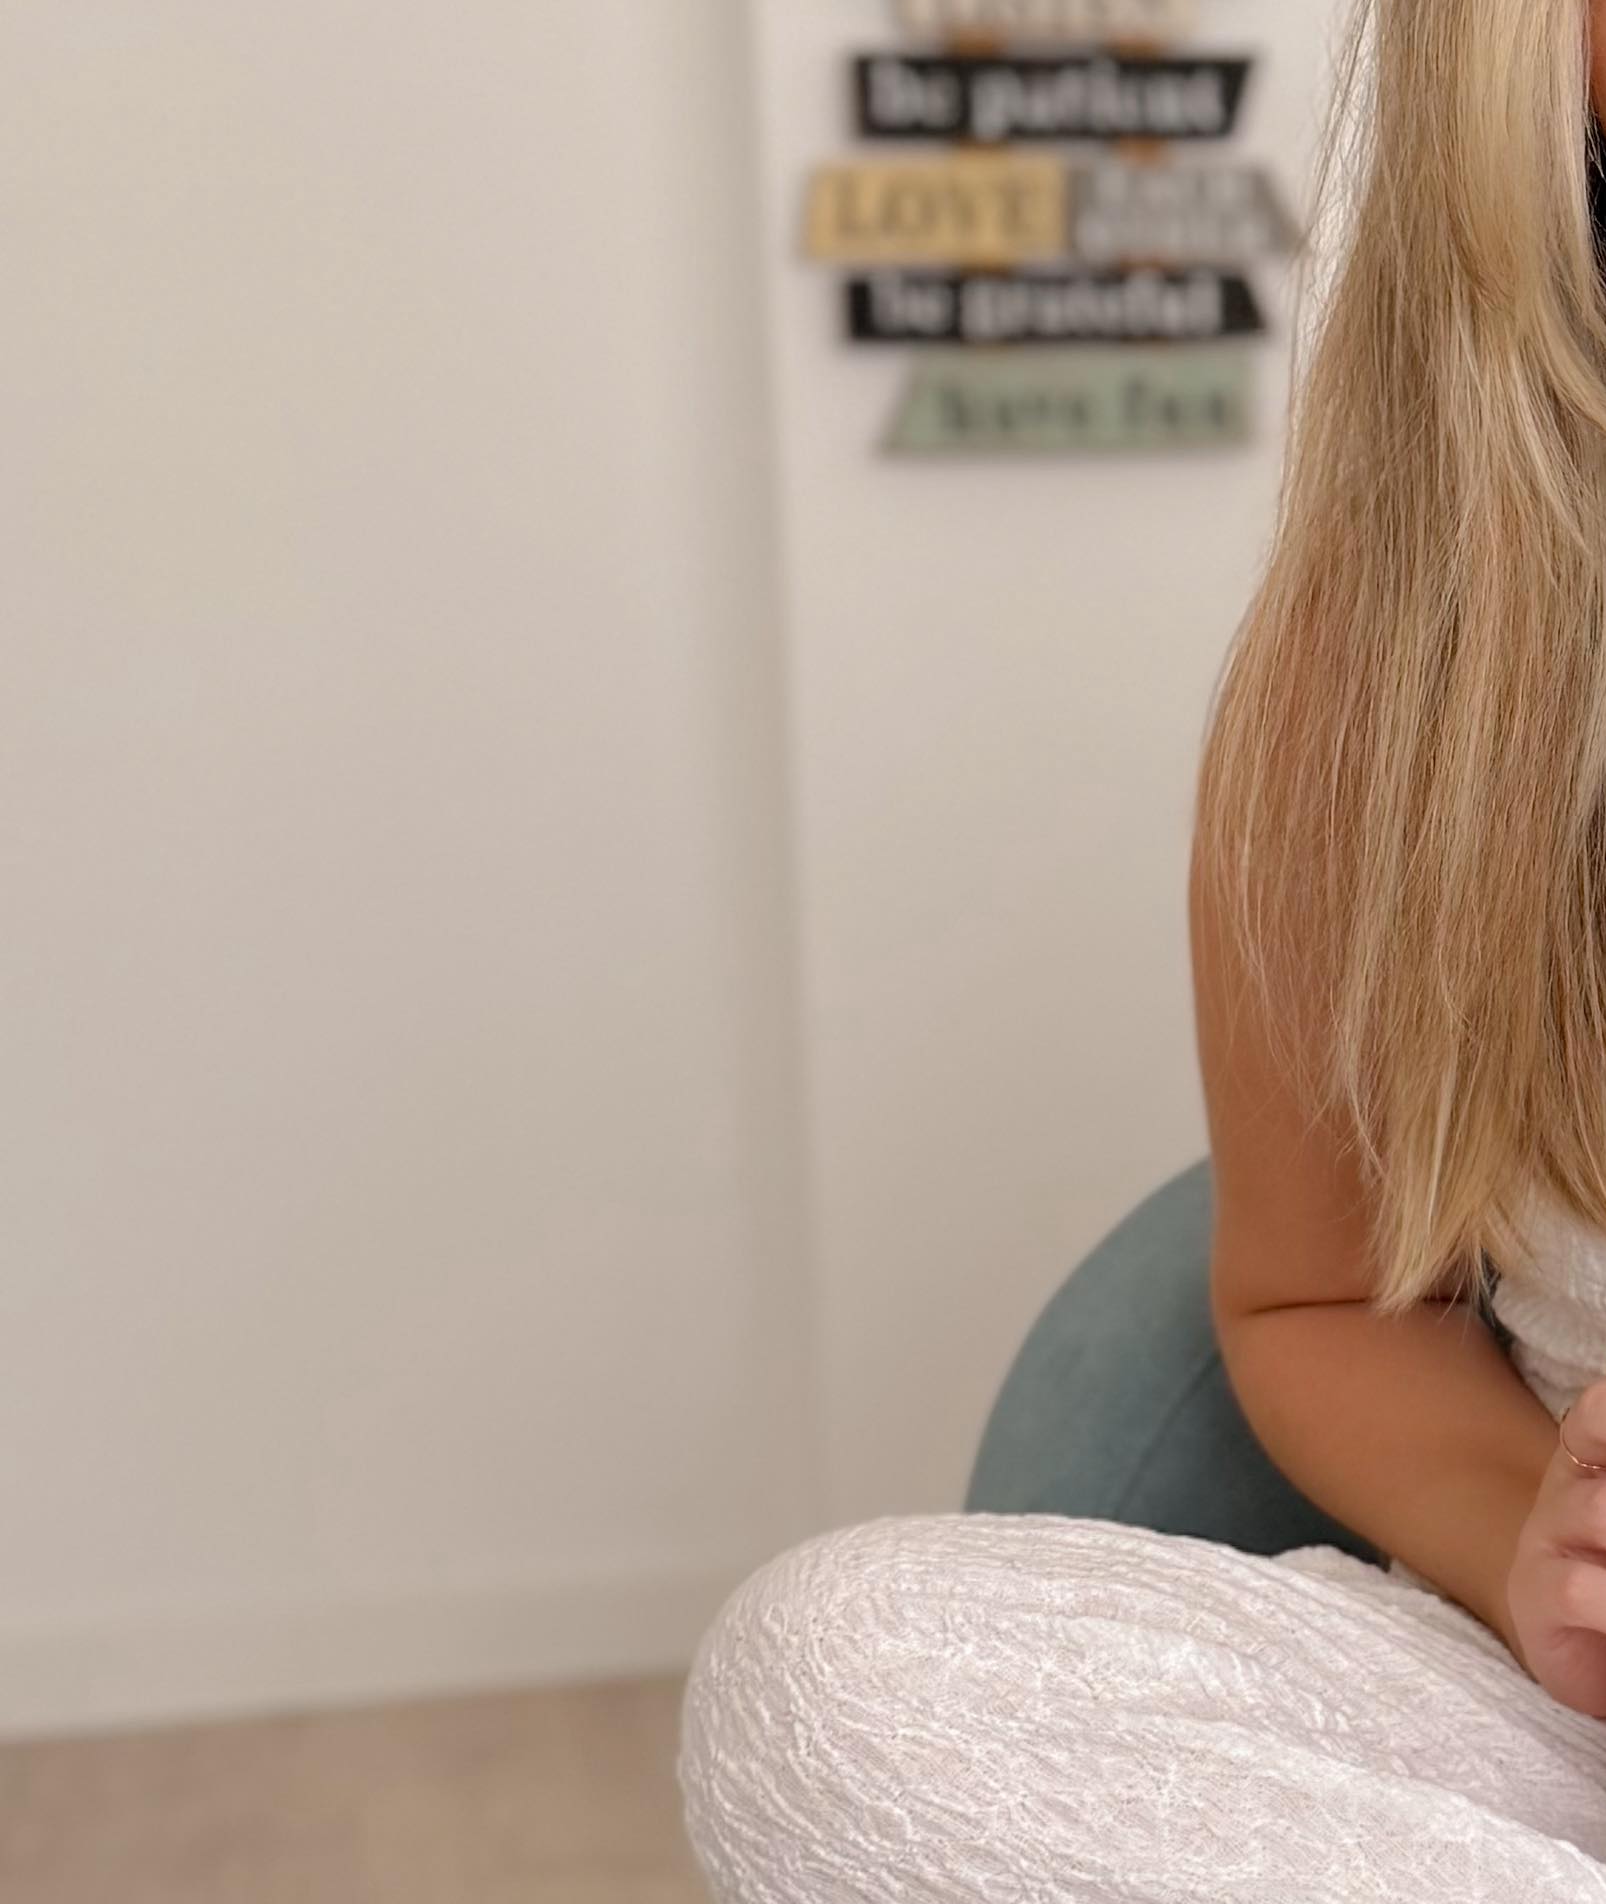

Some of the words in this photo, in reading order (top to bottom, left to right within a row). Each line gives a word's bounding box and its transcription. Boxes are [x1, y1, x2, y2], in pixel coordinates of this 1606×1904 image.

[870, 60, 960, 126] be
[968, 60, 1224, 140] patient
[834, 172, 1044, 242] LOVE
[870, 272, 954, 332] be
